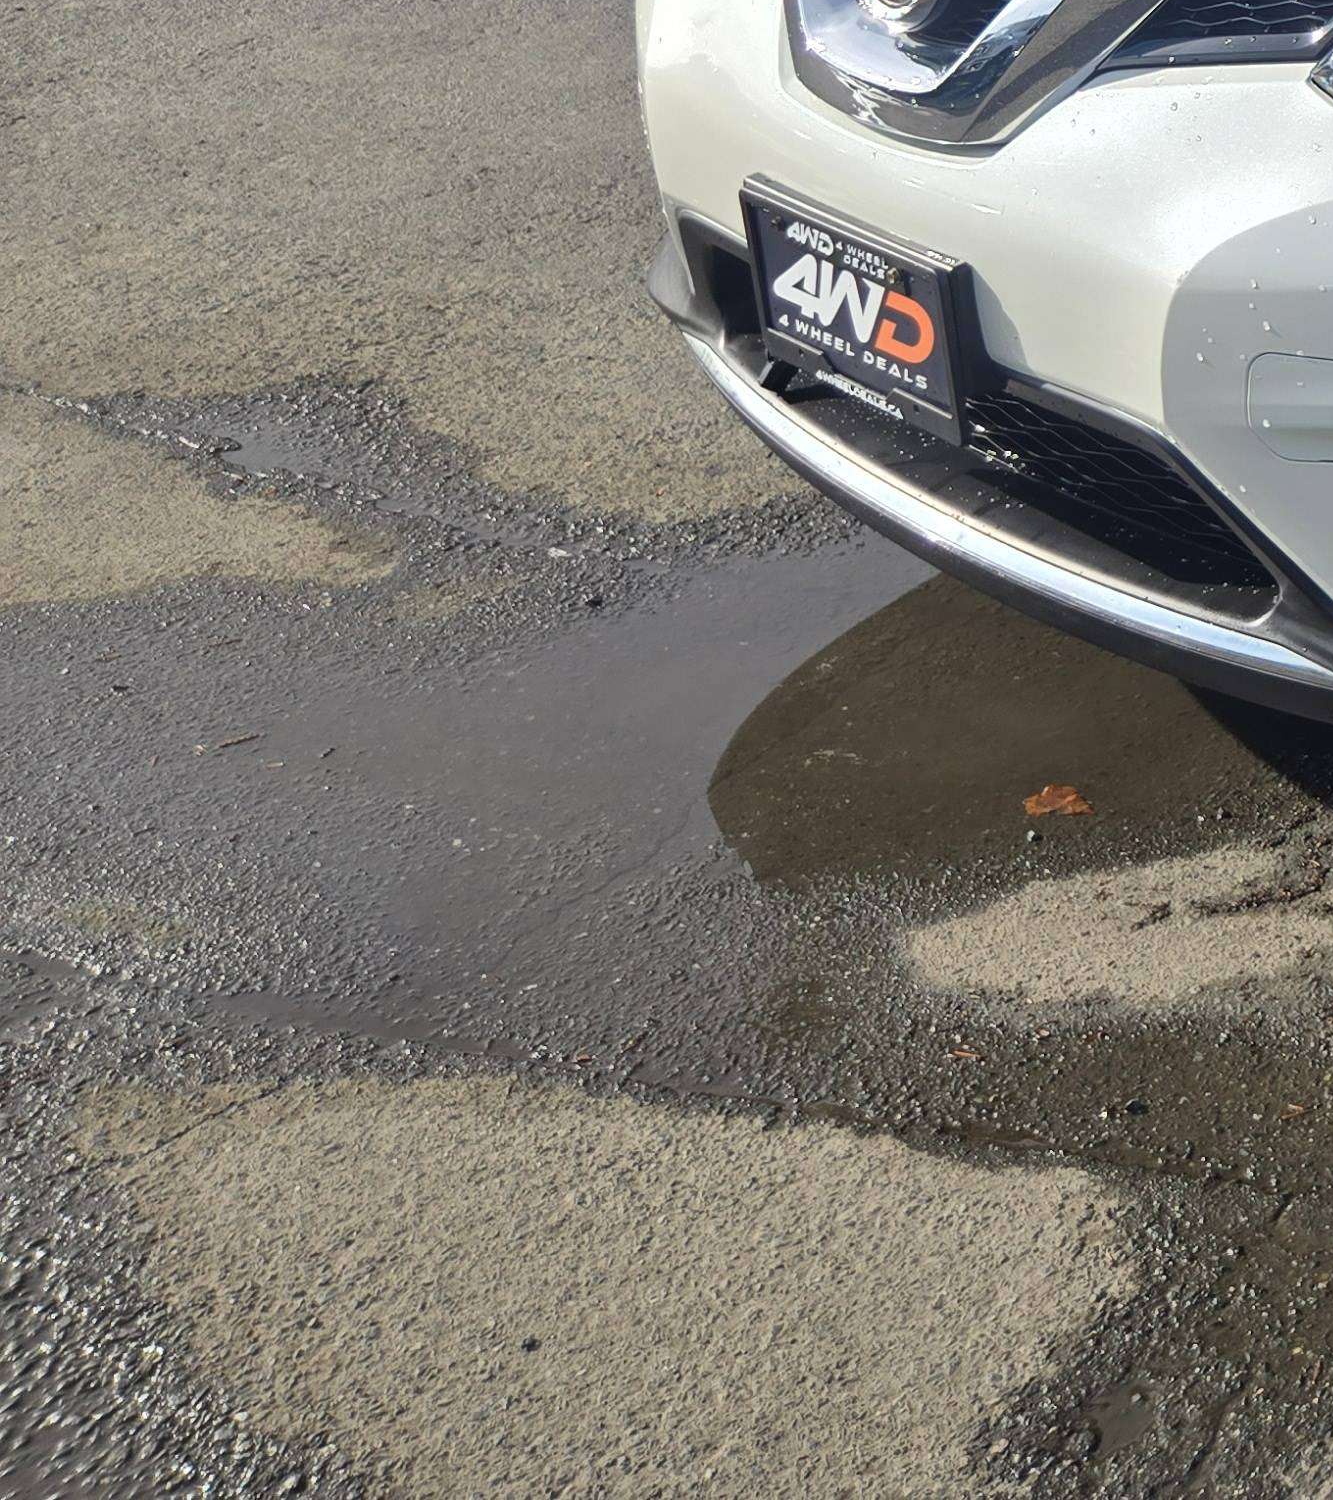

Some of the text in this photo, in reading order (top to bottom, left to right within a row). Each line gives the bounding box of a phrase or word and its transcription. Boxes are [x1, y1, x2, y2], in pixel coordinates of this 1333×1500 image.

[786, 221, 834, 256] 4WD
[843, 254, 886, 280] DEALS
[846, 244, 889, 270] WHEEL
[772, 253, 935, 364] 4WD
[778, 314, 929, 390] 4 WHEEL DEALS
